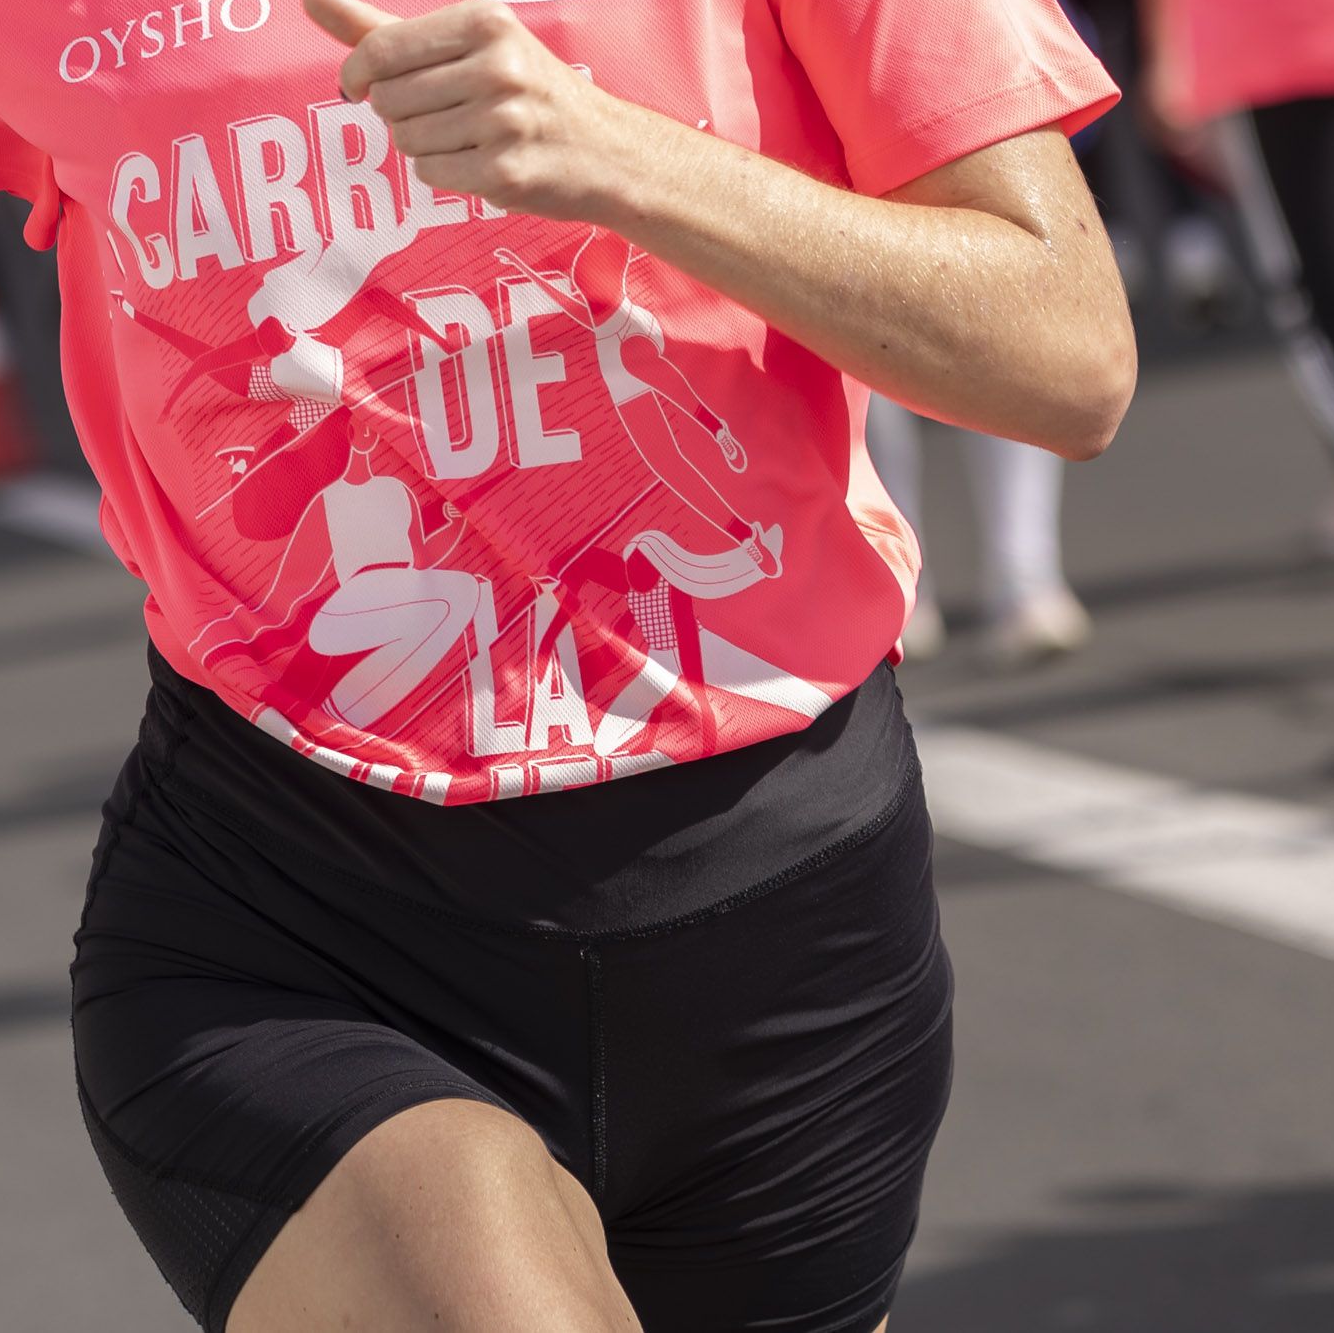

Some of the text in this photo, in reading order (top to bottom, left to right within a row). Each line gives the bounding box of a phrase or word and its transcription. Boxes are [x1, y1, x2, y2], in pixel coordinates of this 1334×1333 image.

[109, 63, 594, 290] CARR
[402, 270, 583, 481] DE
[464, 573, 596, 758] LA
